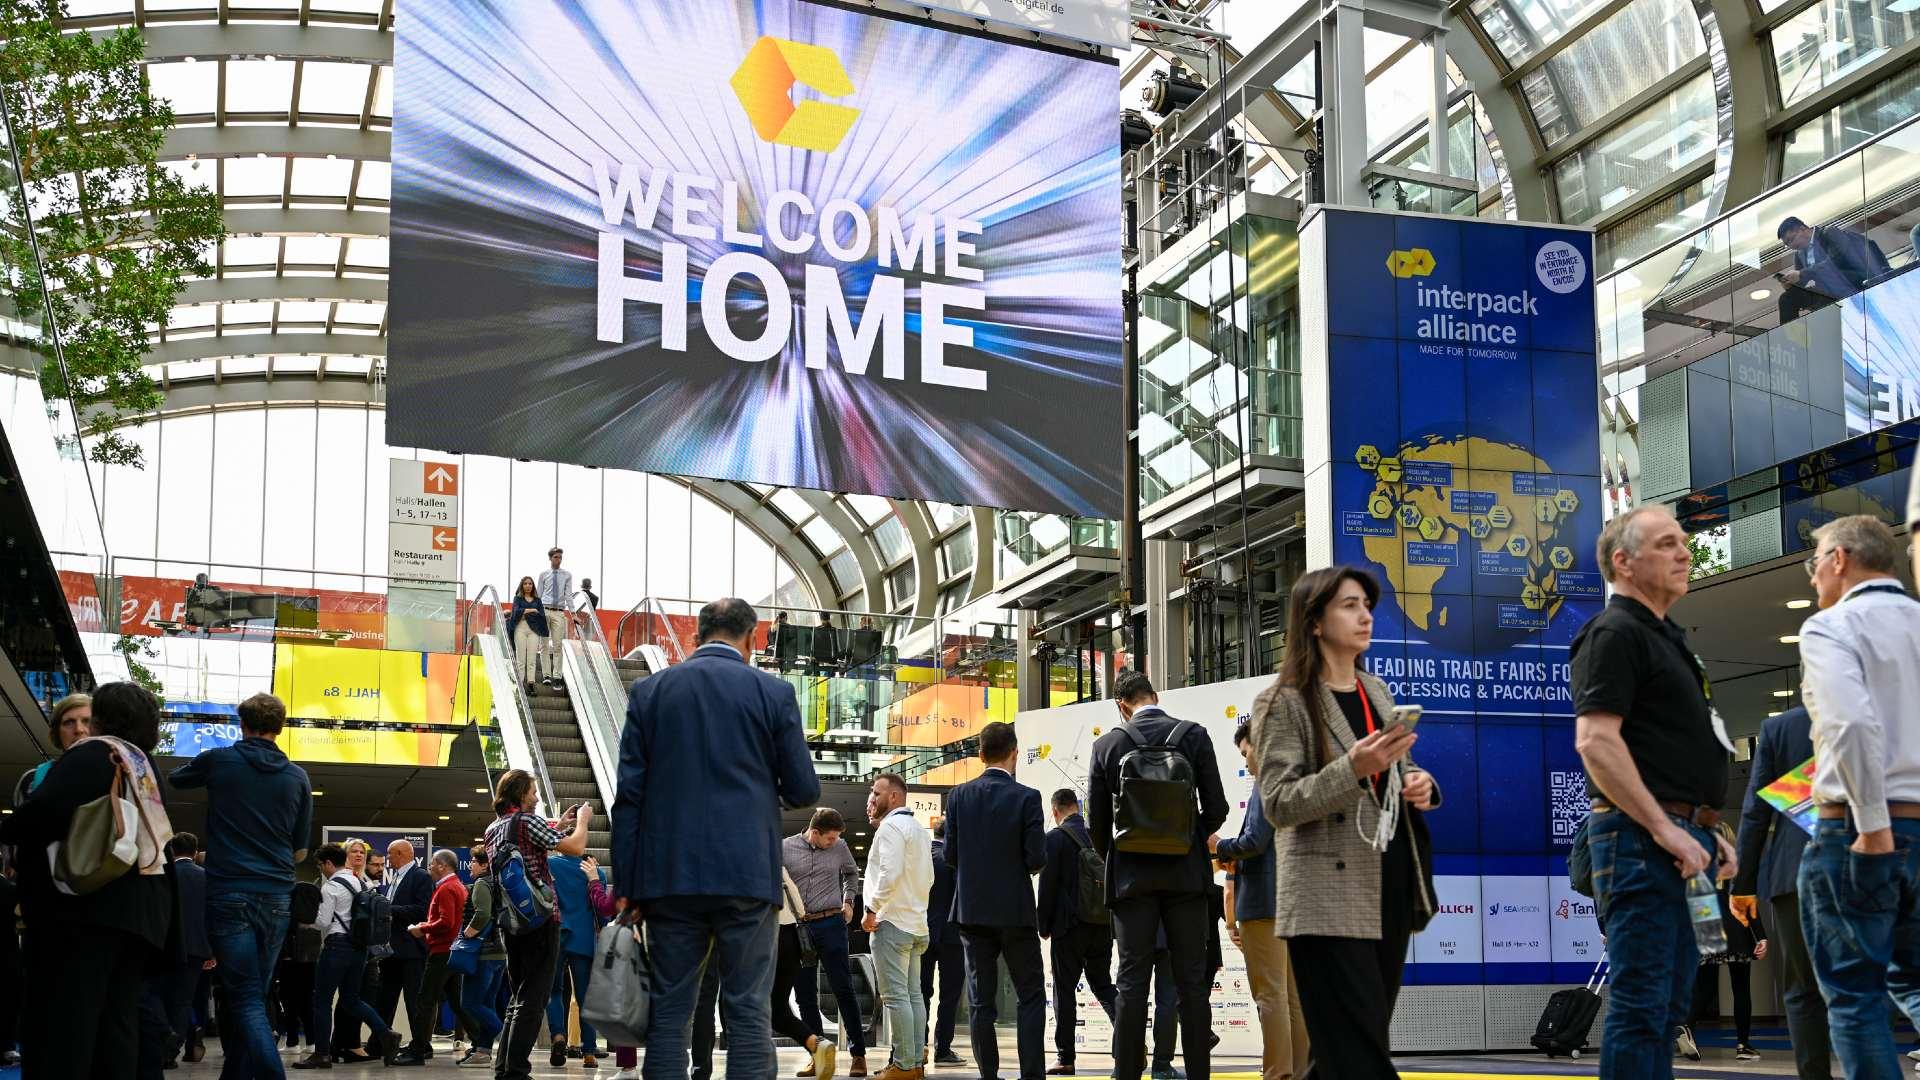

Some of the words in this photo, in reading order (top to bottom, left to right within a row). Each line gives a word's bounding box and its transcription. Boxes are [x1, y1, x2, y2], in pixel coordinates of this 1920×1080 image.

[591, 157, 984, 281] WELCOME
[1544, 251, 1555, 260] SEE
[1556, 249, 1569, 258] YOU
[1540, 262, 1547, 270] IN
[1547, 256, 1579, 268] ENTRANCE
[1547, 267, 1567, 277] NORTH
[1568, 265, 1575, 274] AT
[1417, 282, 1538, 317] interpack
[597, 230, 987, 390] HOME
[1417, 314, 1517, 344] alliance
[1420, 345, 1444, 355] MADE
[1447, 346, 1464, 357] FOR
[1467, 348, 1518, 360] TOMORROW
[395, 495, 446, 508] Halls/Hallen
[394, 548, 443, 561] Restaurant
[351, 628, 385, 640] busine
[1365, 657, 1435, 678] LEADING
[1441, 659, 1494, 680] TRADE
[1500, 661, 1547, 682] FAIRS
[1553, 664, 1571, 682] FO
[1387, 681, 1471, 699] OCESSING
[1477, 684, 1487, 699] &
[1493, 684, 1573, 701] PACKAGIN
[1571, 902, 1594, 915] Tan
